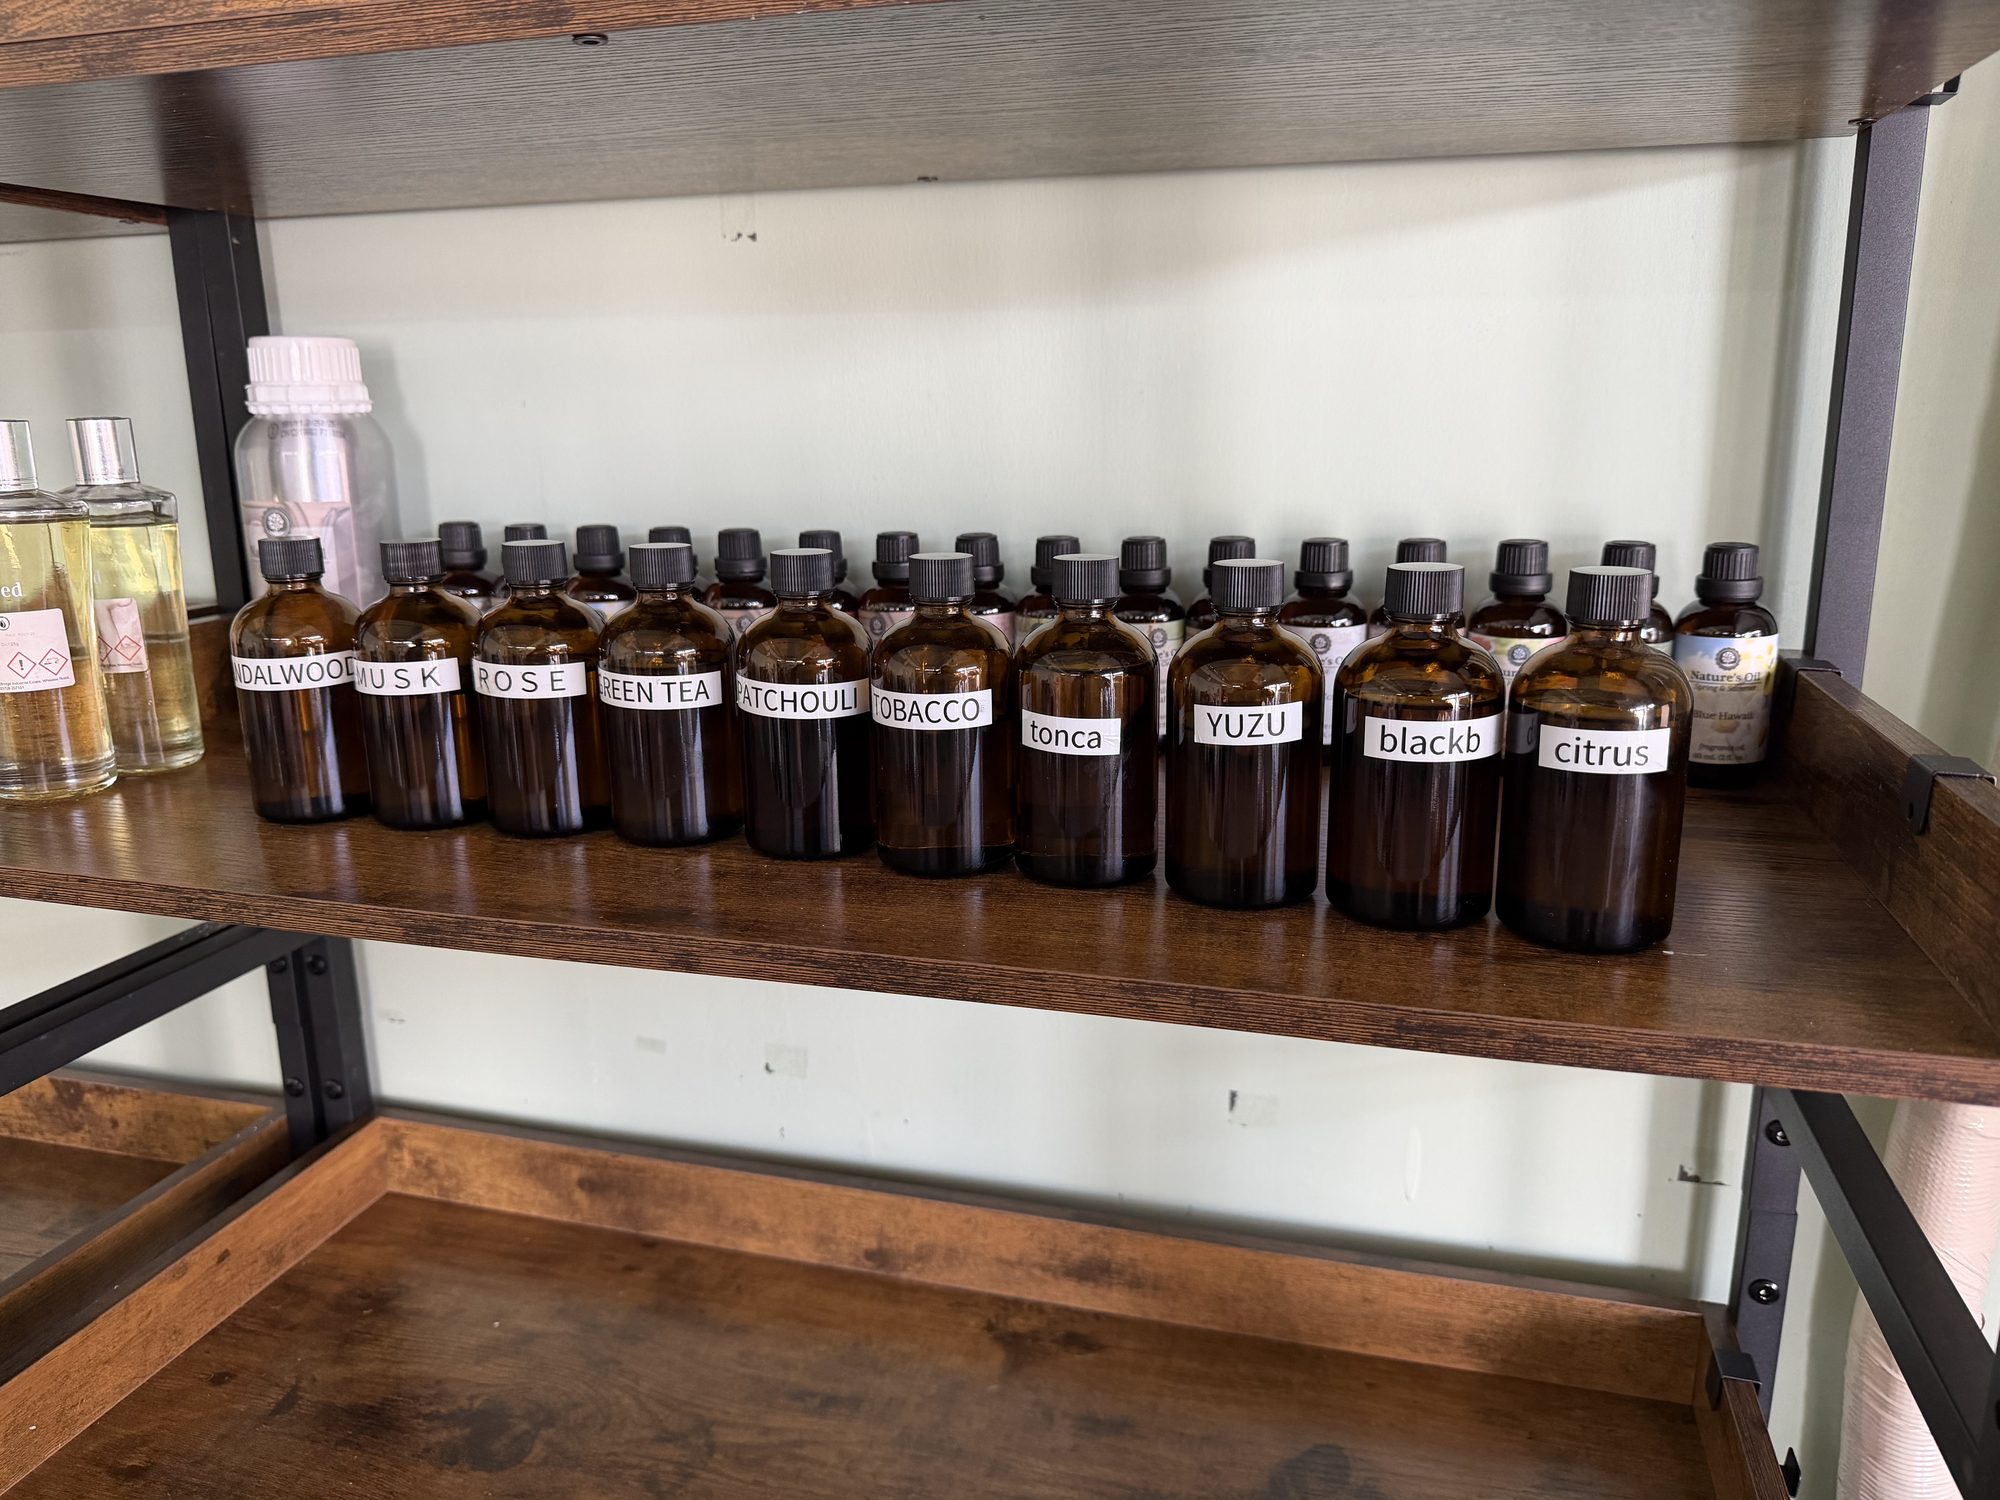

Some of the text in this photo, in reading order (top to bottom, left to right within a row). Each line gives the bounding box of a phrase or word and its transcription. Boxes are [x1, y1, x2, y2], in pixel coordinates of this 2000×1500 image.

[1690, 670, 1760, 683] Nature's Oil
[660, 680, 710, 703] TEA
[737, 681, 857, 713] PATCHOULI
[873, 693, 980, 723] TOBACCO
[1030, 720, 1101, 749] tonca
[1206, 711, 1285, 738] YUZU
[1380, 724, 1480, 755] blackb
[1554, 736, 1649, 767] citrus
